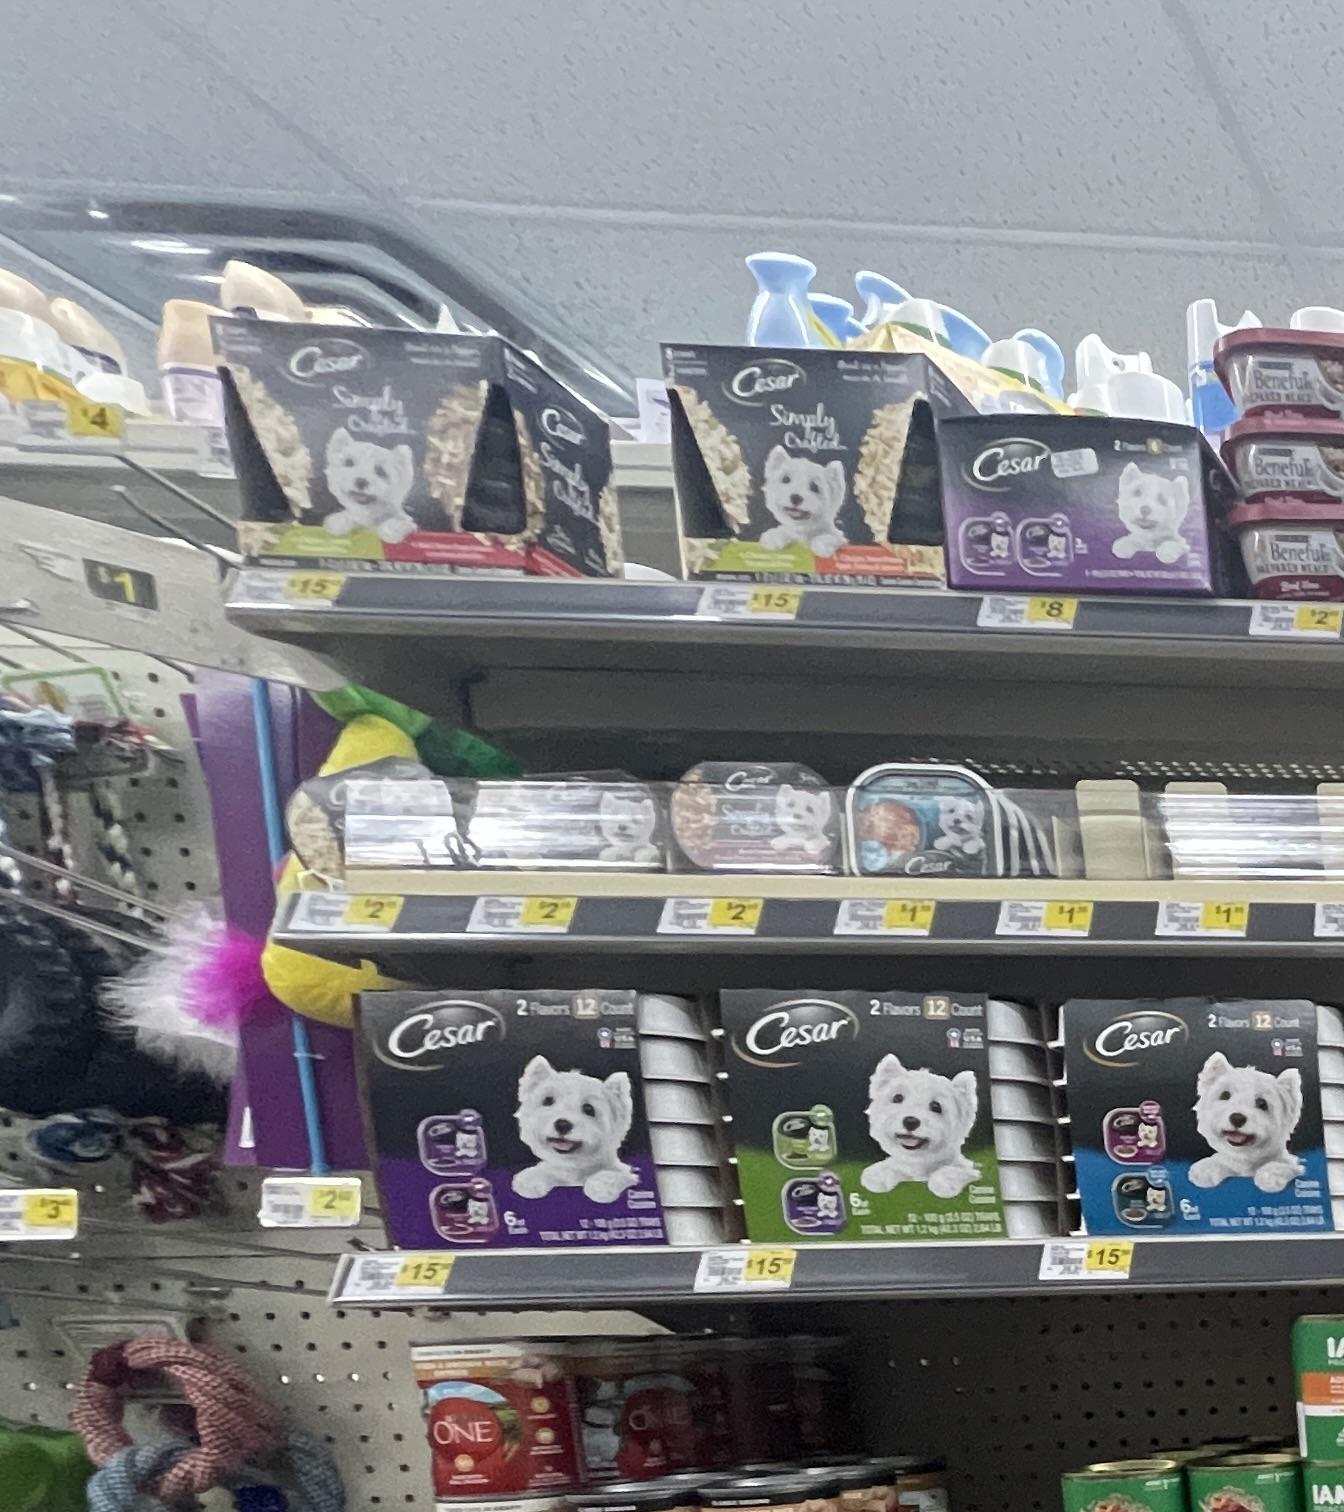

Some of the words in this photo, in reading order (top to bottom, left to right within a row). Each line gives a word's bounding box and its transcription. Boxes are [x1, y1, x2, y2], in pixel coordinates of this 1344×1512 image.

[771, 404, 836, 434] Simply
[972, 447, 1048, 484] Cesar
[517, 1000, 527, 1016] 2
[576, 999, 596, 1016] 12
[870, 999, 880, 1015] 2
[927, 999, 946, 1015] 12
[1208, 1014, 1217, 1028] 2
[1255, 1014, 1270, 1028] 12
[388, 1014, 496, 1058] Cesar
[746, 1012, 847, 1056] Cesar
[1095, 1021, 1180, 1056] Cesar
